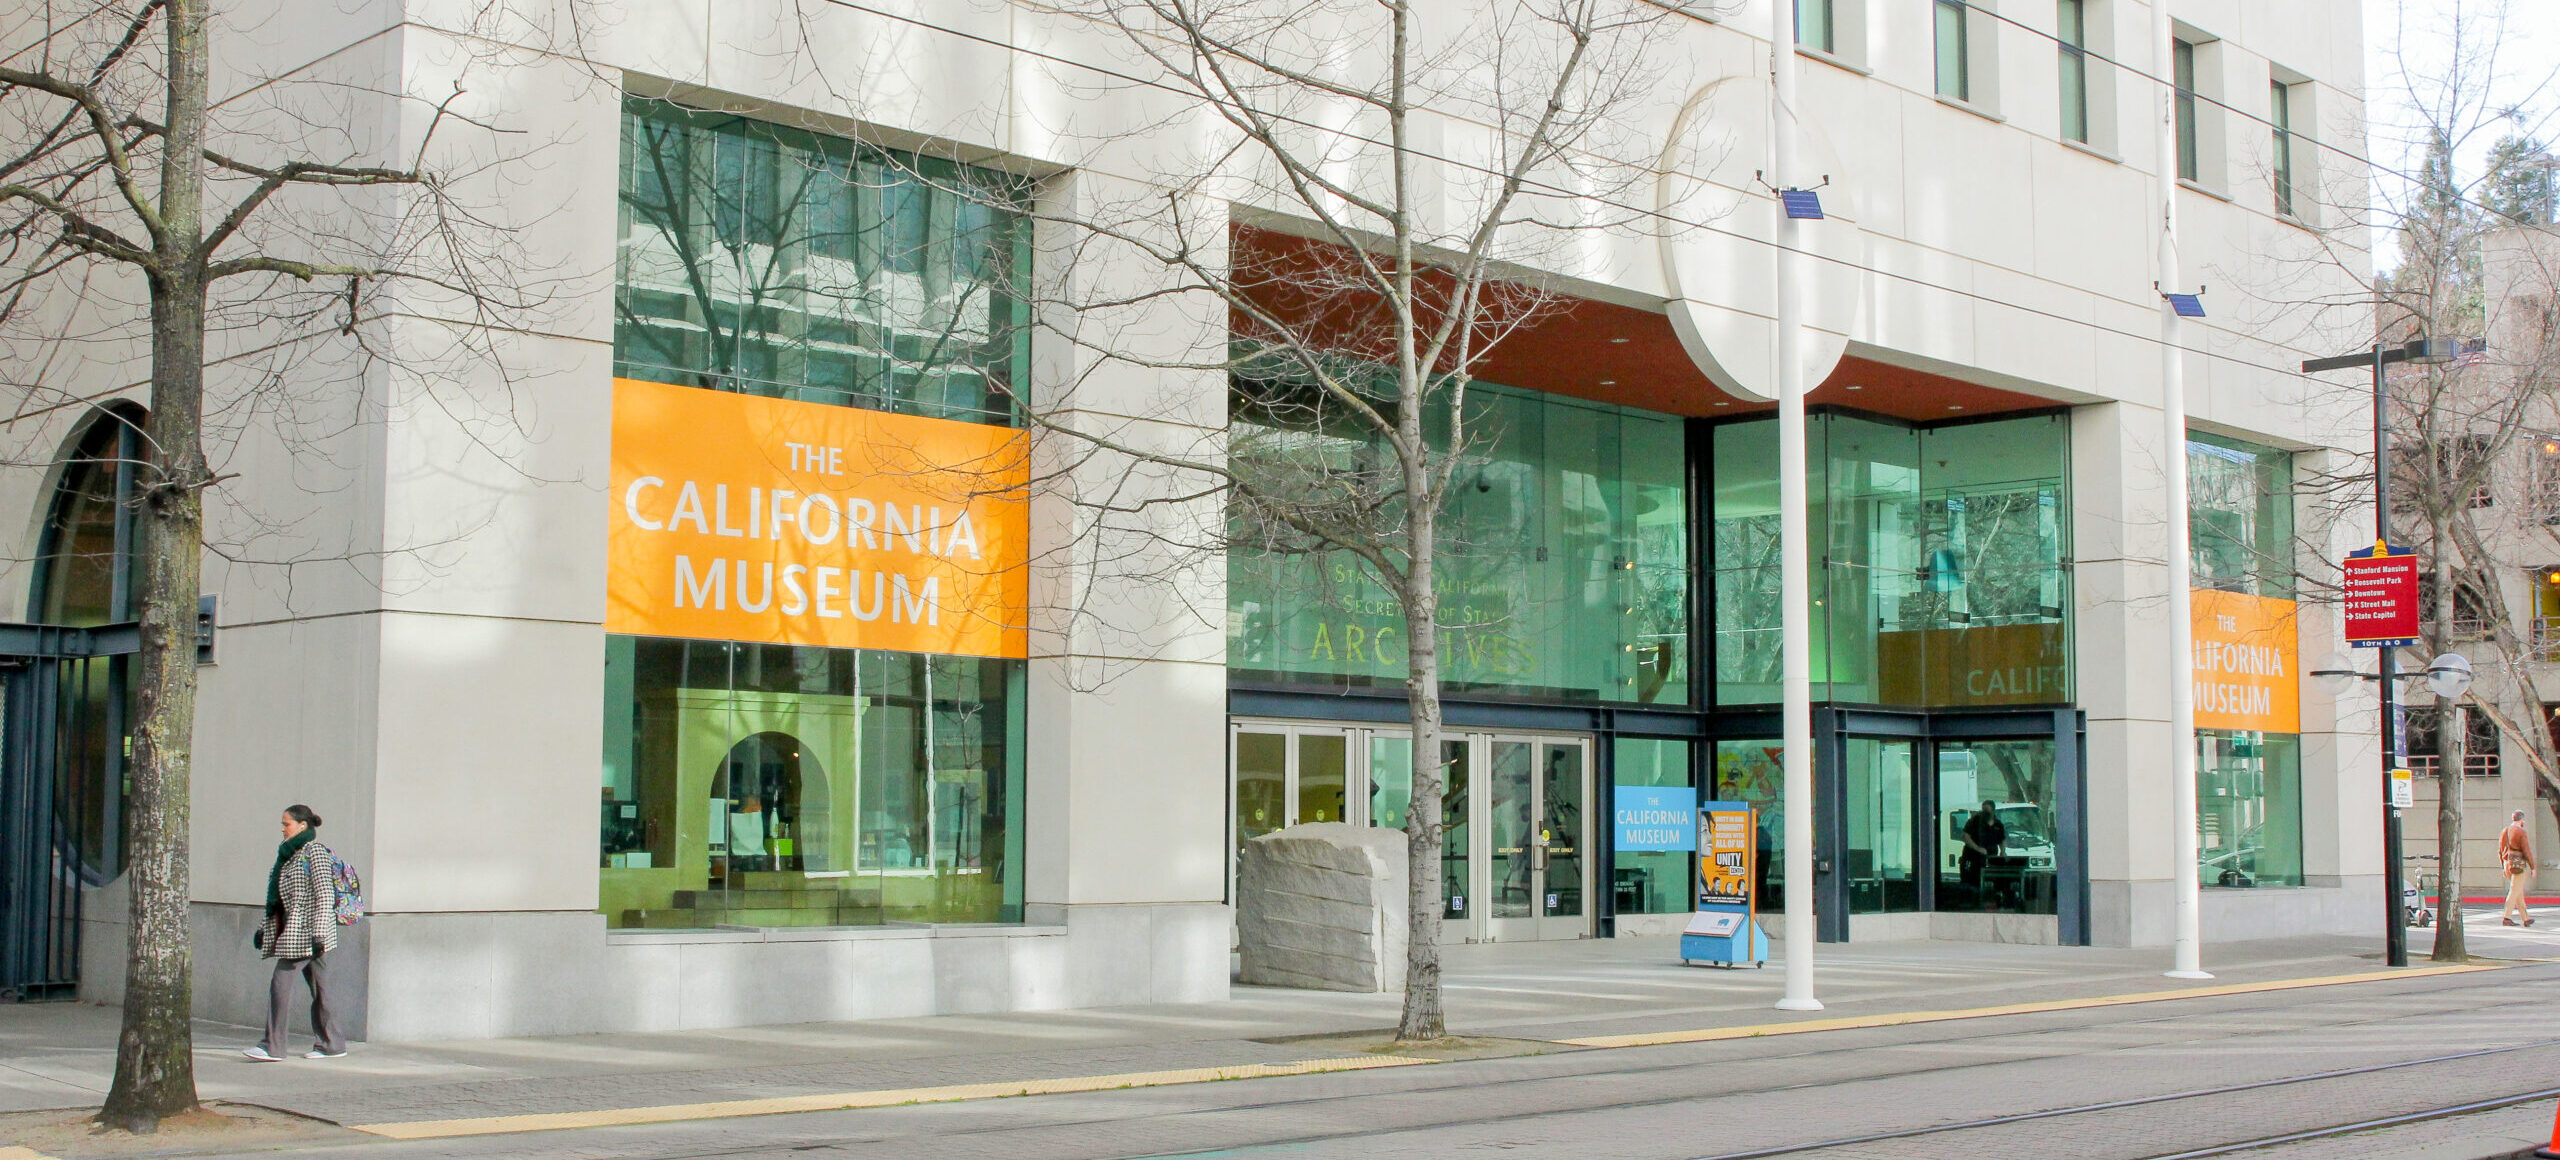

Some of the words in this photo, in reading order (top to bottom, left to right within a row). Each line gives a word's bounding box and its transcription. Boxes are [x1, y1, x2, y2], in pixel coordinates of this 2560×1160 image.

[785, 441, 843, 476] THE
[625, 476, 981, 560] CALIFORNIA
[2354, 567, 2381, 575] Stanford
[2382, 565, 2408, 573] Mansion
[2354, 578, 2385, 586] Roosevelt
[674, 555, 939, 626] MUSEUM
[2216, 614, 2236, 632] THE
[2354, 612, 2371, 620] State
[2372, 611, 2396, 620] Capitol
[1310, 622, 1537, 674] ARCIVES
[2192, 640, 2284, 677] LIFORNIA
[1647, 797, 1659, 805] THE
[1617, 810, 1689, 825] CALIFORNIA
[1626, 829, 1680, 844] MUSEUM
[1715, 839, 1727, 848] ALL
[1727, 839, 1735, 848] OF
[1735, 839, 1745, 848] US
[1716, 853, 1741, 866] UNITY
